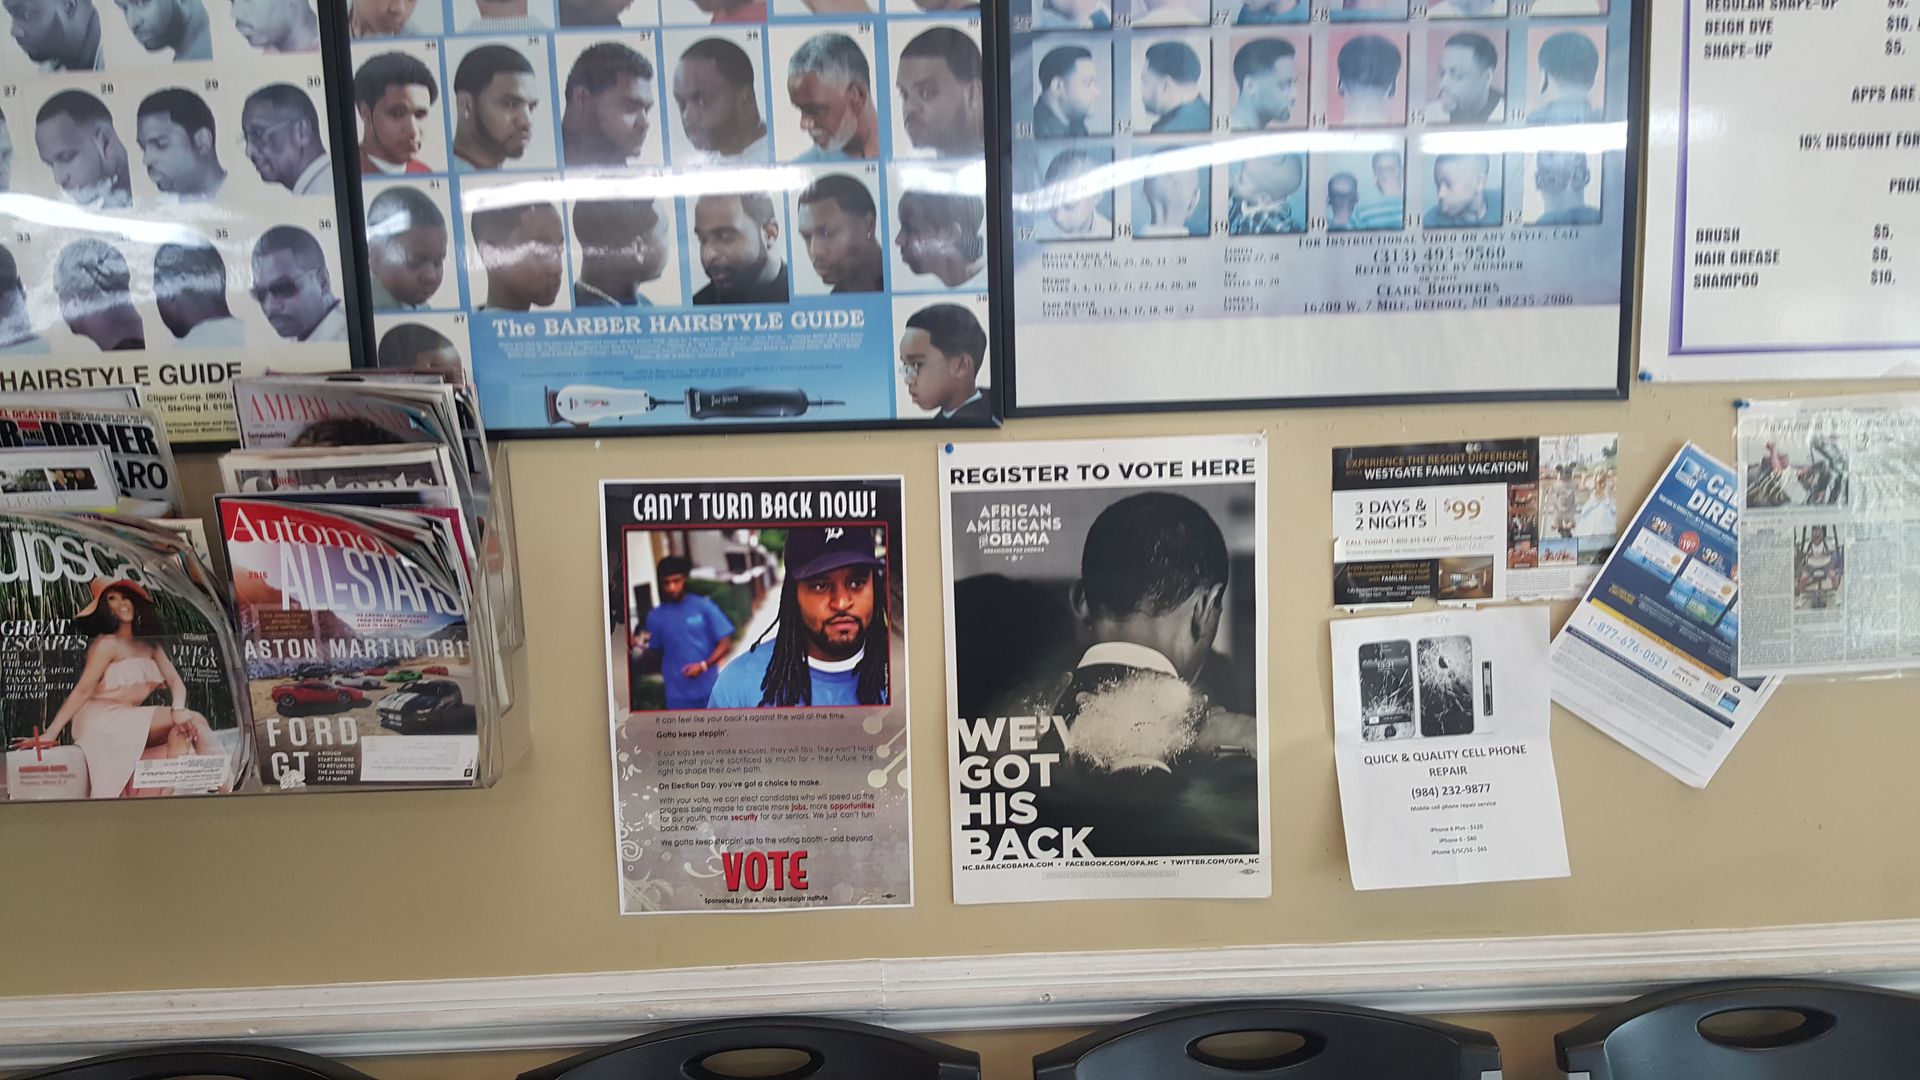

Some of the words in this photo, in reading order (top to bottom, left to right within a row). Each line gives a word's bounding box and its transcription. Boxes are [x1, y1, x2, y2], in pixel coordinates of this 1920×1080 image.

[1704, 41, 1773, 59] SHAPE-UP
[1826, 132, 1892, 150] DISCOUNT
[1696, 227, 1740, 244] BRUSH
[1374, 249, 1416, 262] (313)
[1694, 250, 1725, 267] HAIR
[1730, 248, 1780, 266] GREASE
[1377, 283, 1421, 296] CLARK
[1428, 281, 1500, 296] BROTHERS
[1694, 272, 1759, 290] SHAMPOO
[492, 318, 536, 338] The
[544, 316, 642, 337] BARBER
[650, 312, 784, 334] HAIRSTYLE
[791, 309, 865, 329] GUIDE
[0, 366, 151, 392] HAIRSTYLE
[147, 394, 177, 403] Clipper
[206, 392, 226, 401] (800)
[13, 410, 57, 420] DISASTER
[168, 405, 201, 413] Sterling
[40, 421, 159, 455] DRIVER
[1345, 456, 1404, 468] EXPERIENCE
[1408, 454, 1425, 465] THE
[1428, 452, 1465, 464] RESORT
[1468, 451, 1528, 462] DIFFERENCE
[950, 465, 1069, 484] REGISTER
[1077, 464, 1110, 480] TO
[1119, 461, 1183, 479] VOTE
[1191, 458, 1256, 477] HERE
[1365, 466, 1422, 480] WESTGATE
[1426, 463, 1465, 477] FAMILY
[1468, 461, 1529, 475] VACATION!
[633, 492, 693, 520] CAN'T
[699, 492, 754, 520] TURN
[760, 491, 812, 519] BACK
[820, 490, 877, 518] NOW!
[980, 503, 1051, 518] AFRICAN
[1355, 501, 1363, 515] 3
[1369, 499, 1410, 515] DAYS
[1416, 498, 1426, 512] &
[966, 517, 1061, 533] AMERICANS
[1355, 518, 1364, 531] 2
[1369, 514, 1427, 530] NIGHTS
[990, 532, 1049, 546] OBAMA
[1, 619, 71, 636] GREAT
[2, 635, 88, 651] ESCAPES
[245, 638, 318, 660] ASTON
[330, 638, 417, 658] MARTIN
[266, 717, 358, 747] FORD
[679, 730, 697, 738] keep
[1364, 754, 1398, 765] QUICK
[1402, 753, 1410, 762] &
[1413, 750, 1459, 762] QUALITY
[1462, 748, 1486, 759] CELL
[1489, 745, 1527, 757] PHONE
[271, 752, 309, 783] GT
[960, 753, 1059, 789] GOT
[1429, 766, 1467, 777] REPAIR
[719, 781, 742, 789] you've
[744, 780, 756, 788] got
[764, 779, 789, 787] choice
[1411, 787, 1439, 799] (984)
[1442, 783, 1491, 796] 232-9877
[830, 802, 874, 811] opportunities
[961, 791, 1037, 825] HIS
[731, 813, 758, 822] security
[962, 827, 1096, 861] BACK
[722, 851, 808, 892] VOTE
[962, 862, 1053, 871] NC.BARACKOBAMA.COM
